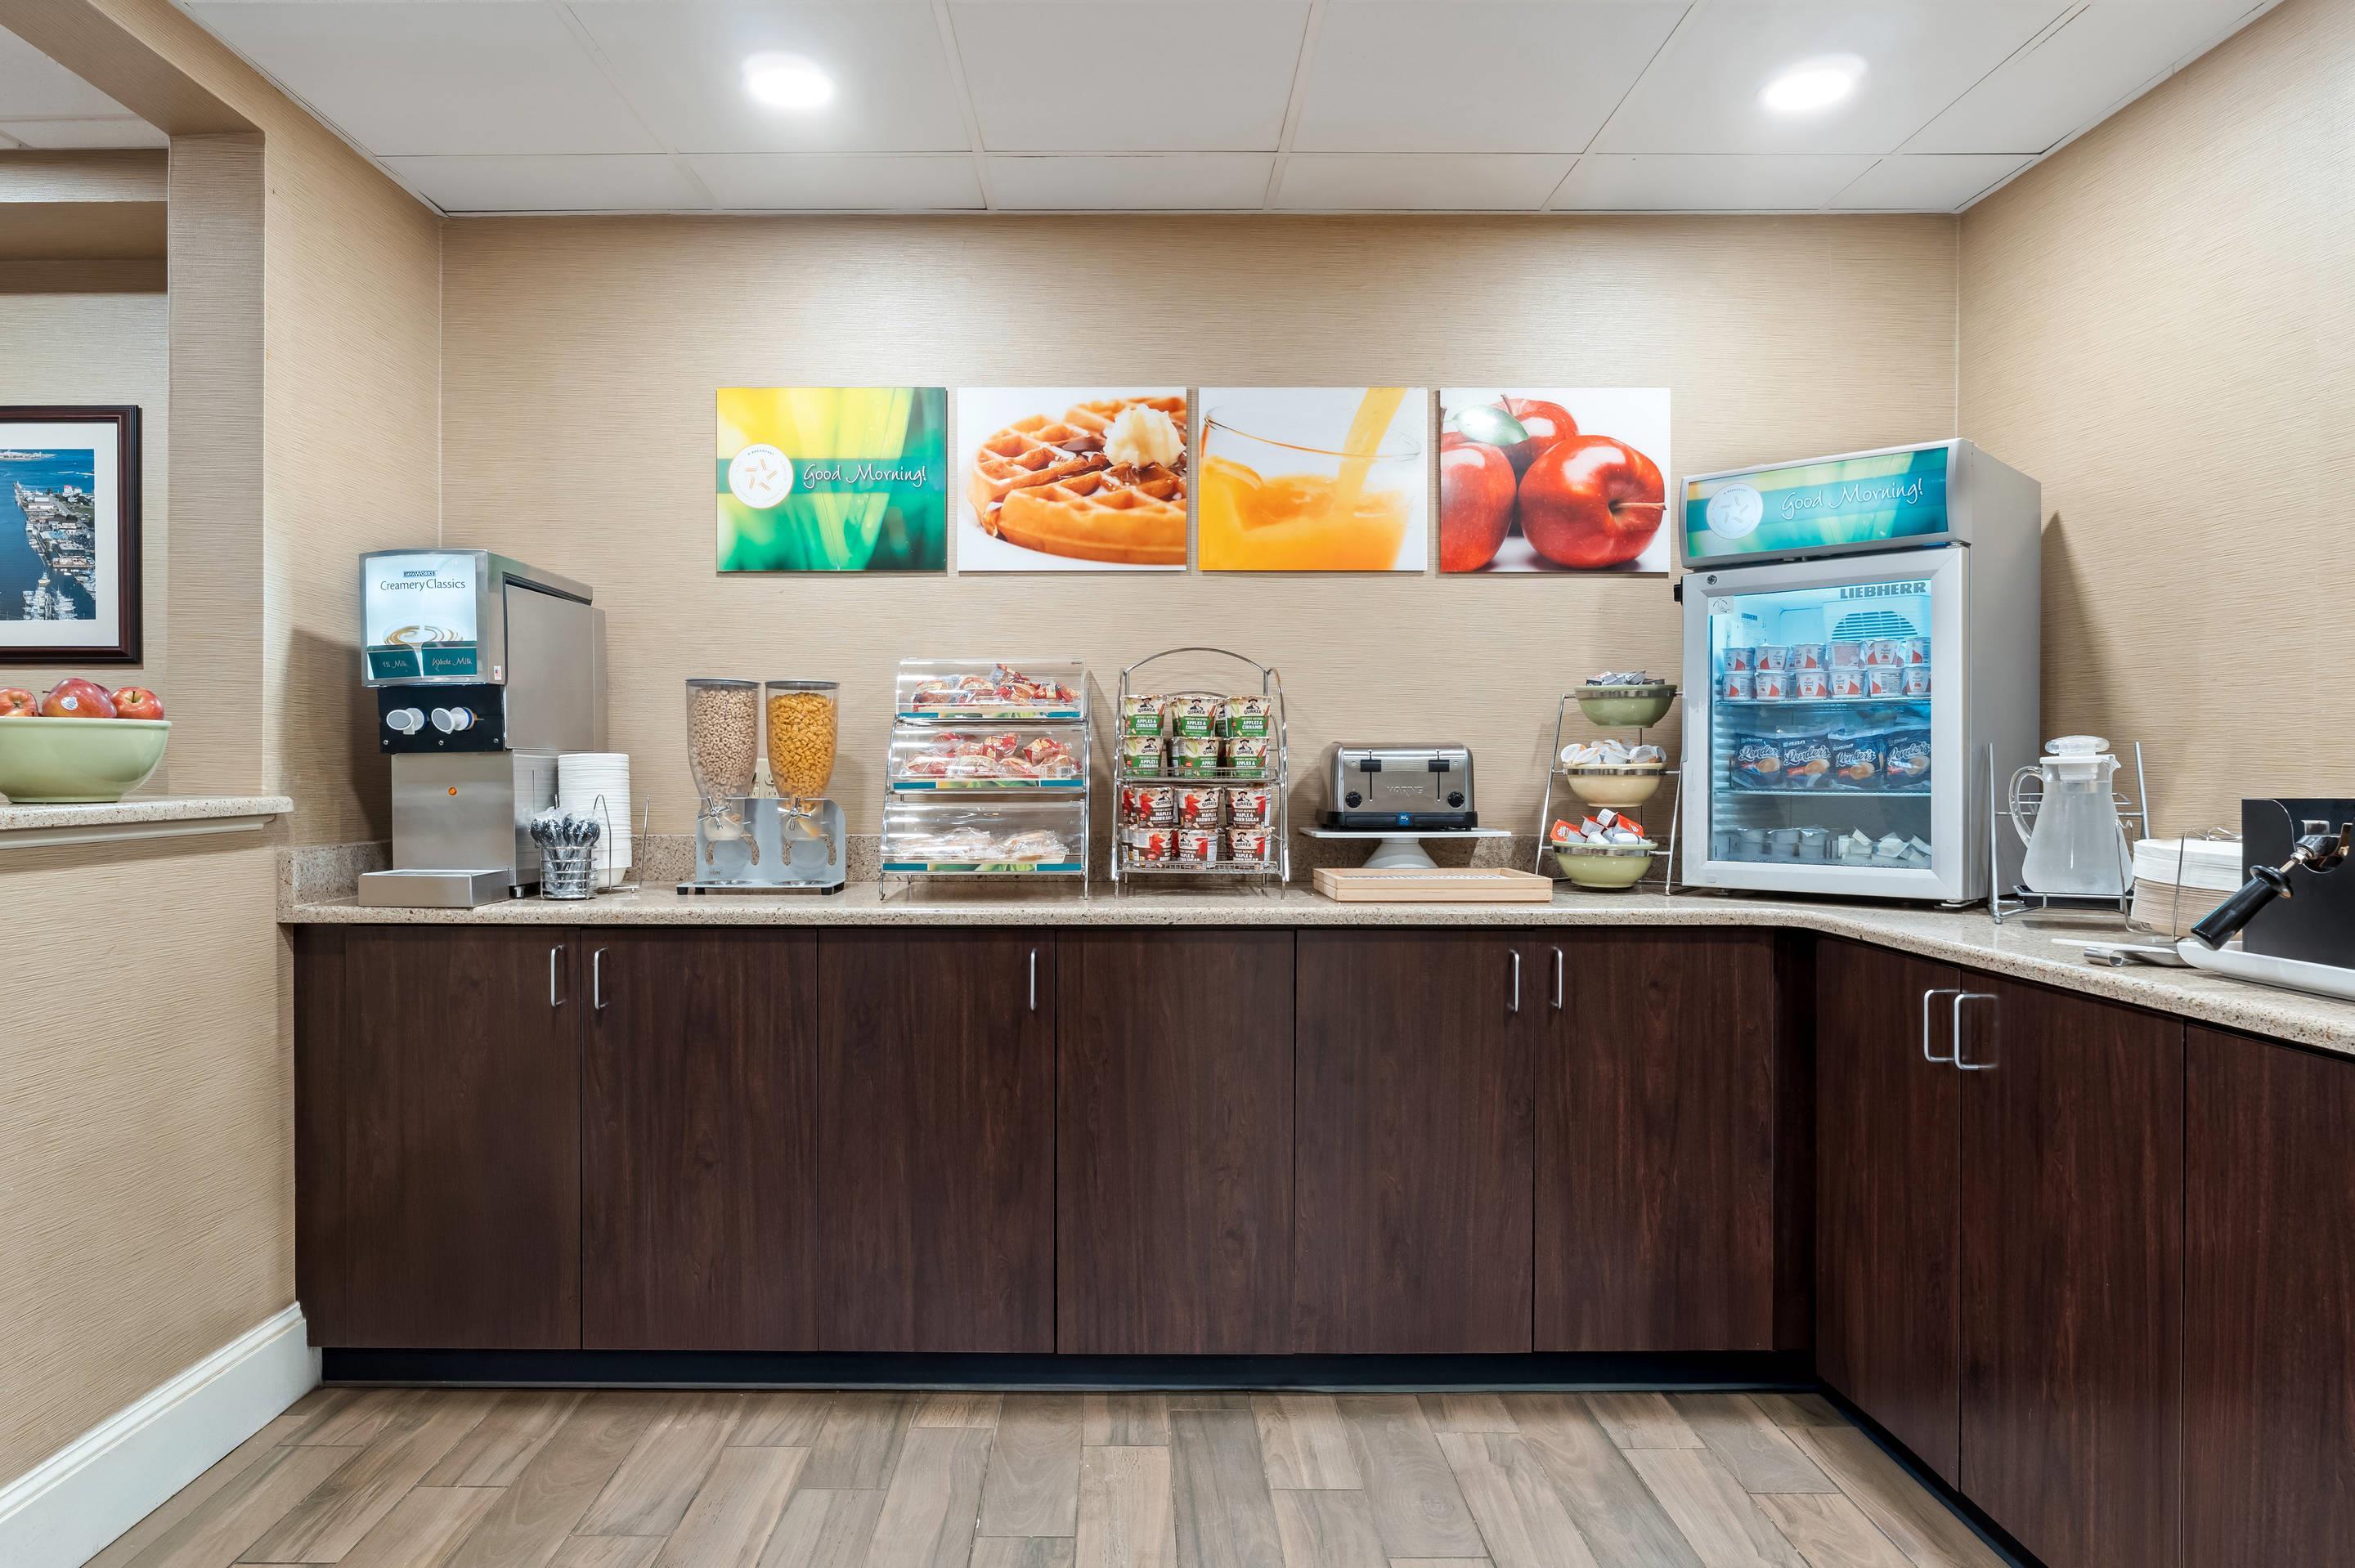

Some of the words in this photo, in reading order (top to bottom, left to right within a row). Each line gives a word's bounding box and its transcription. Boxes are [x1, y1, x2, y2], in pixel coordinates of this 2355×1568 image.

[803, 464, 841, 489] Good
[846, 464, 927, 487] Morning!
[1781, 490, 1823, 519] Good
[1828, 478, 1923, 509] Morning!
[380, 580, 425, 592] Creamery
[426, 578, 466, 589] Classics
[1840, 582, 1927, 599] LIEBHERR
[432, 657, 451, 666] Whole
[452, 656, 473, 666] Milk
[1783, 745, 1832, 766] Lender's
[1835, 748, 1877, 767] Lender's
